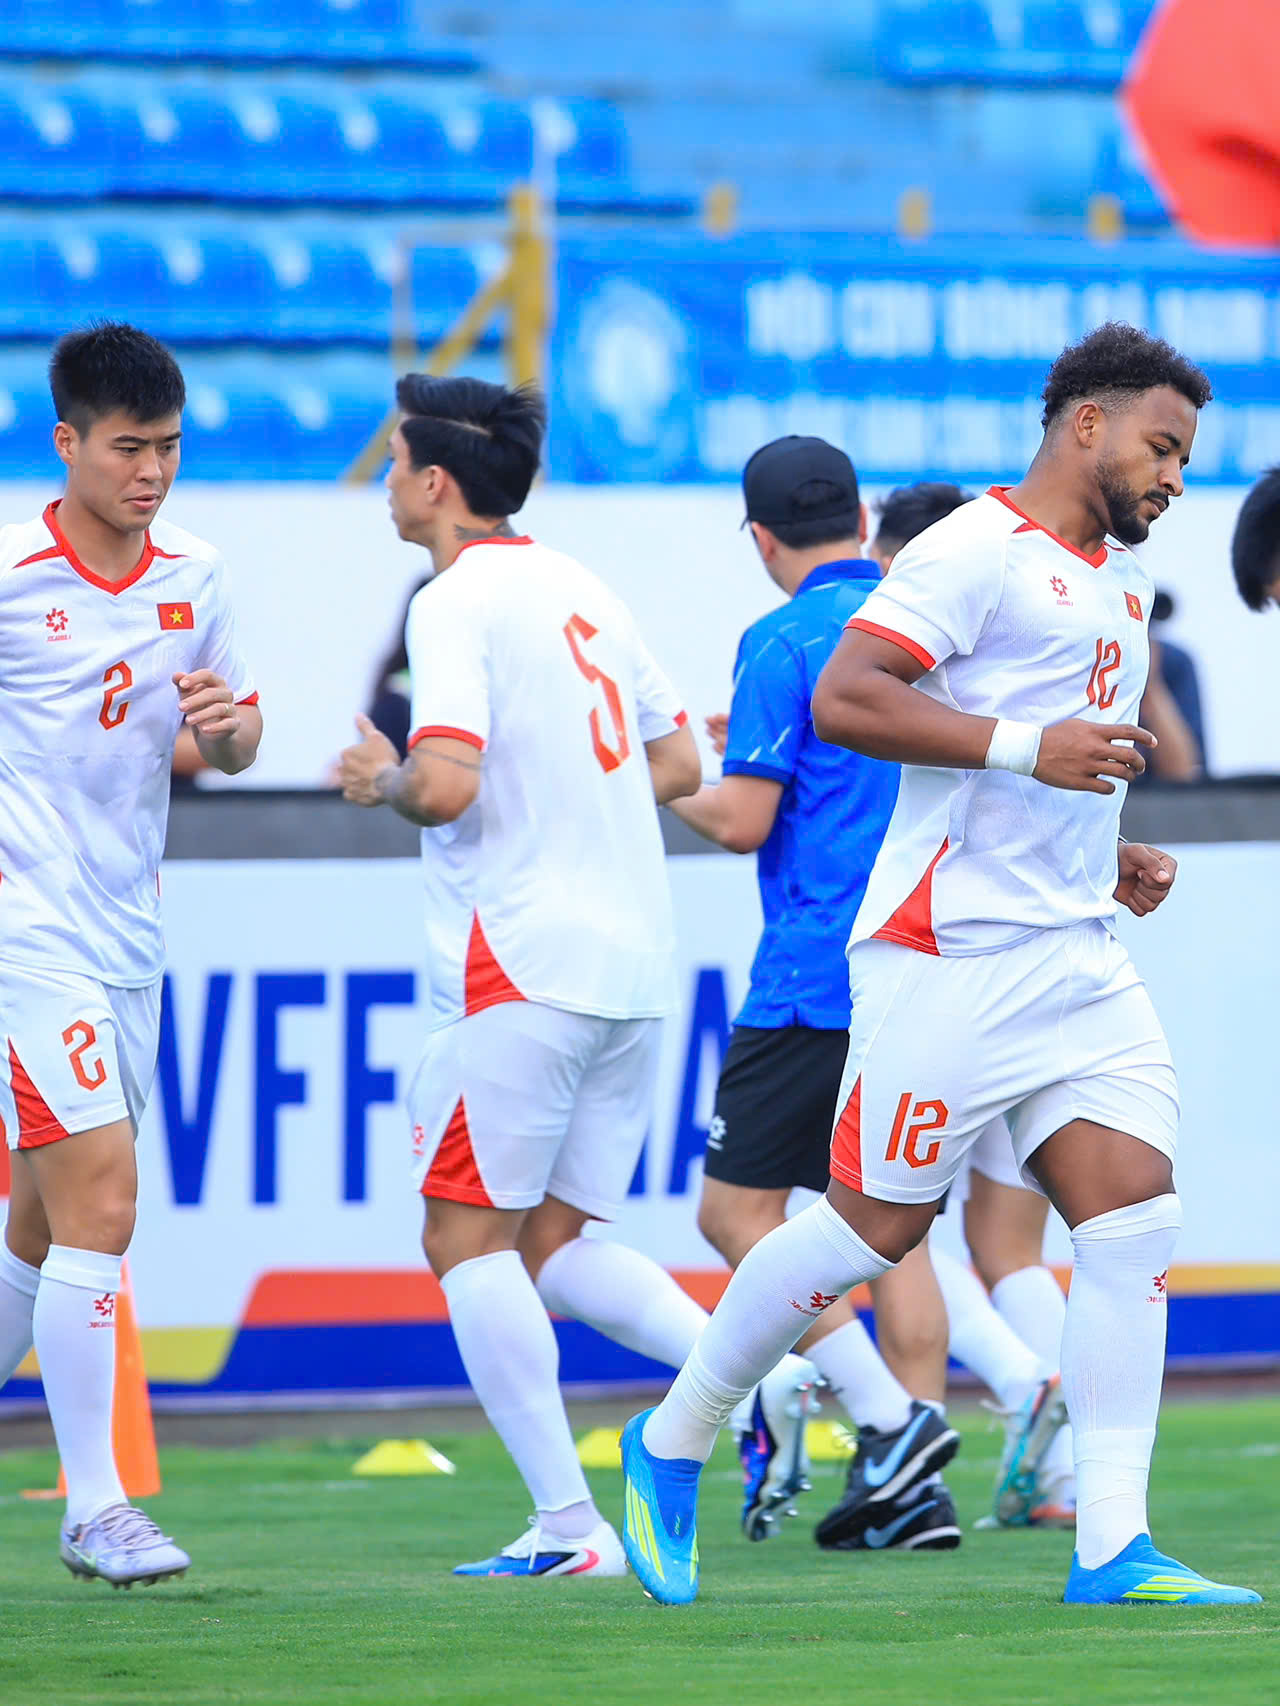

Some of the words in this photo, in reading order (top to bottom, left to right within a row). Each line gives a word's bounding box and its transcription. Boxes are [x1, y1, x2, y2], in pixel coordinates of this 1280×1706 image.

[99, 660, 133, 731] 2
[562, 612, 631, 774] 5
[1086, 636, 1122, 711] 12
[61, 1019, 107, 1091] 2
[158, 971, 417, 1205] VFF
[884, 1091, 950, 1169] 12
